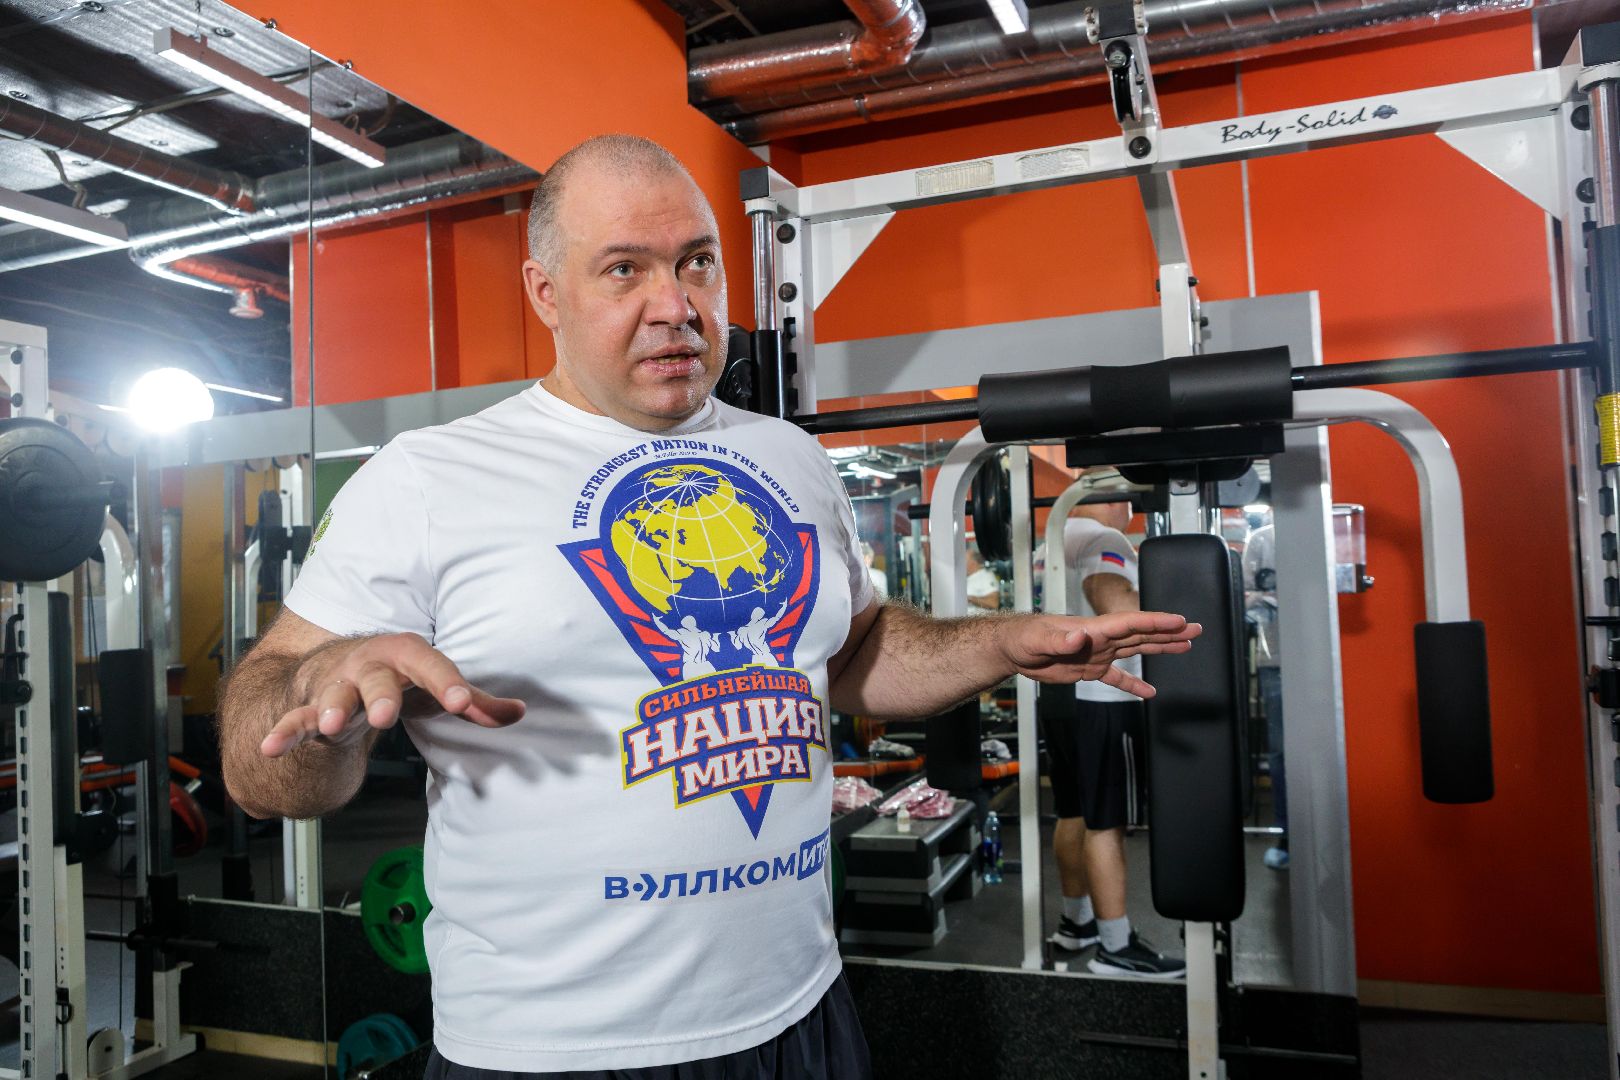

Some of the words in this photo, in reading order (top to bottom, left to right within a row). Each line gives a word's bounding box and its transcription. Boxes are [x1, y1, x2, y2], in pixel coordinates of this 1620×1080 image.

[1221, 106, 1367, 143] Body-Solid
[650, 439, 709, 452] NATION
[712, 444, 728, 456] IN
[731, 450, 758, 472] THE
[580, 443, 648, 499] STRONGEST
[760, 470, 800, 513] WORLD
[572, 500, 591, 529] THE
[644, 672, 811, 719] СИЛЬНЕЙШАЯ
[628, 697, 824, 778] НАЦИЯ
[681, 744, 807, 797] МИРА
